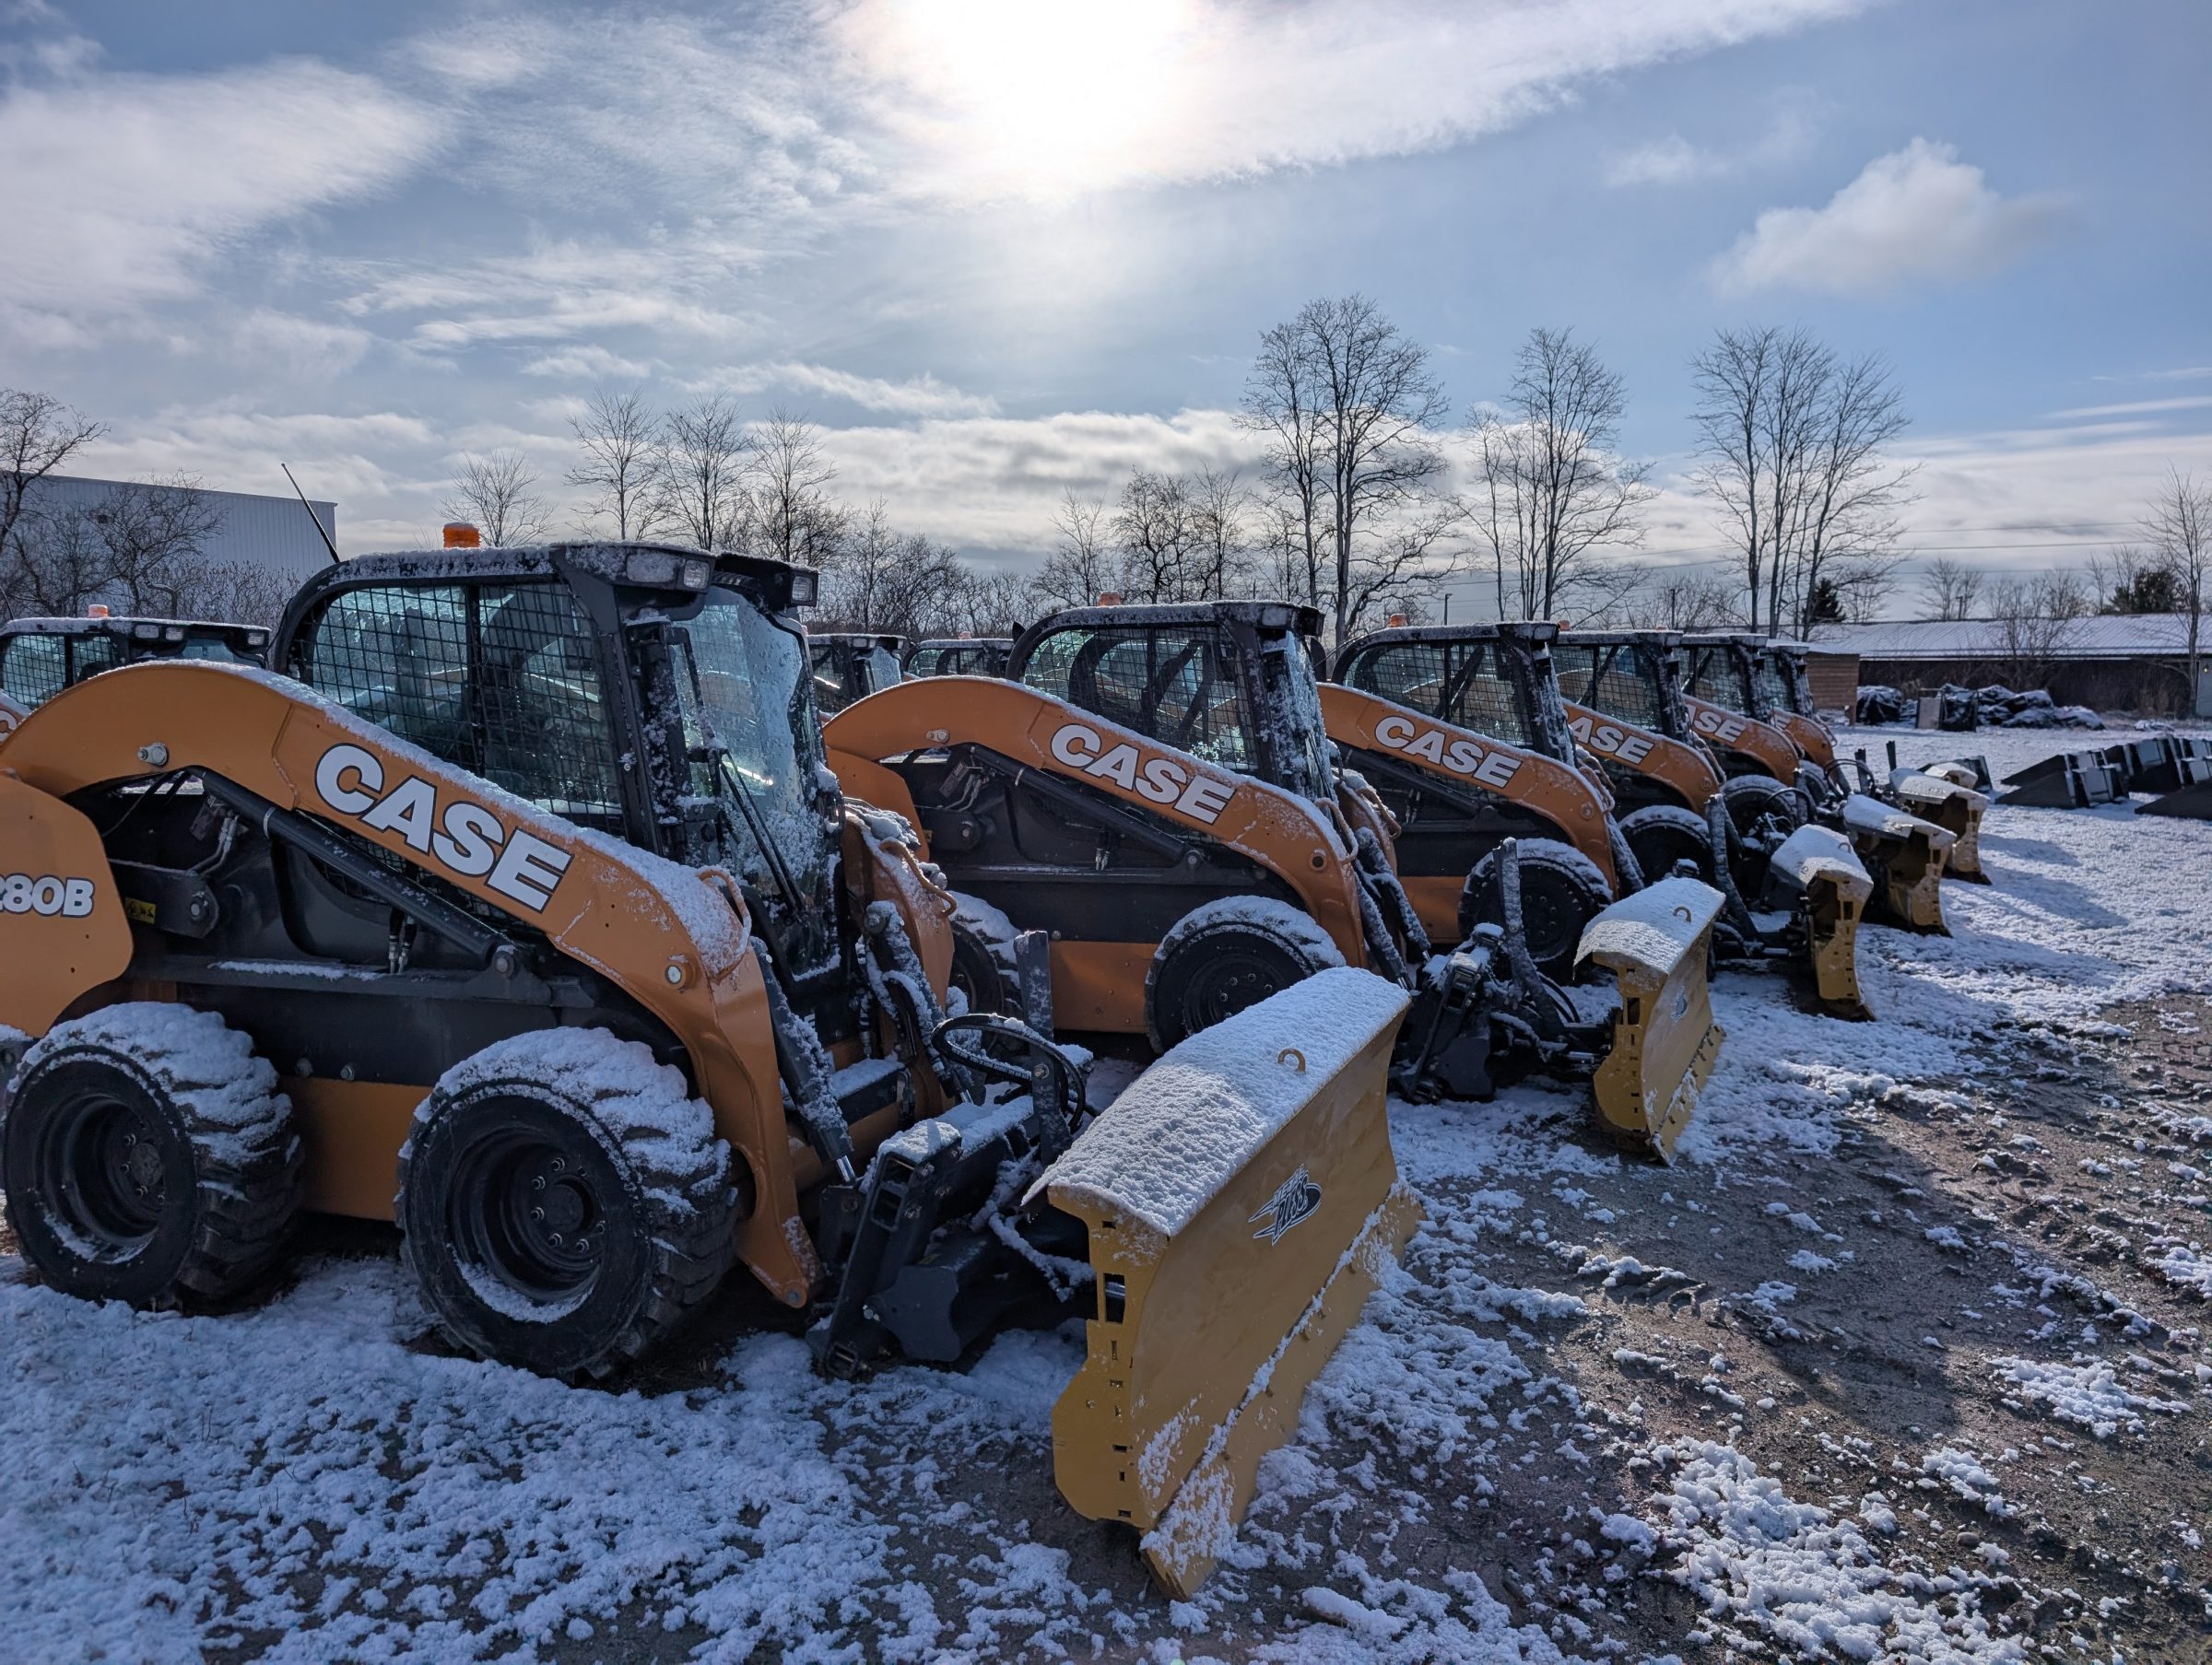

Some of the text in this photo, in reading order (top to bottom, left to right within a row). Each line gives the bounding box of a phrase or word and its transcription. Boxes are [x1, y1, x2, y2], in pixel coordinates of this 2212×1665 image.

[1051, 722, 1238, 826] CASE
[1374, 715, 1523, 788] CASE
[1563, 707, 1655, 766] ASE
[314, 742, 575, 914] CASE
